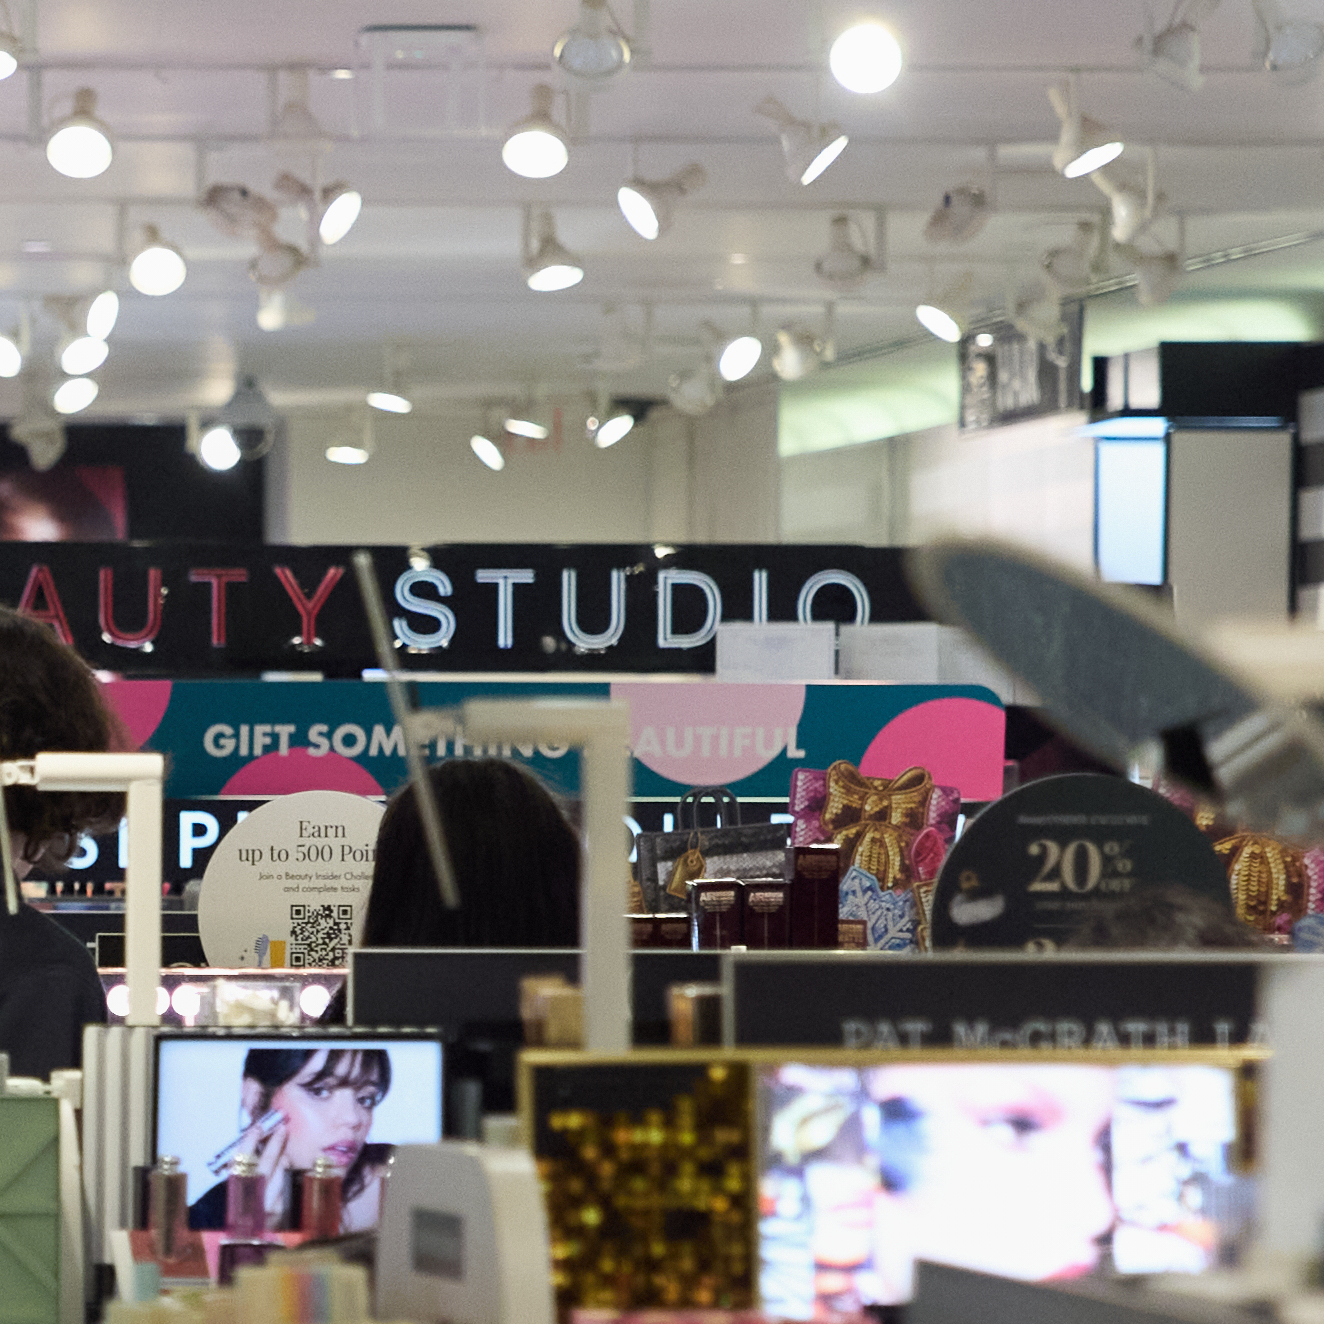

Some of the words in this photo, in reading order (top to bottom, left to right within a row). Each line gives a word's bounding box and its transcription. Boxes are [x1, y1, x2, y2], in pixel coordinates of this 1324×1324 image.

[391, 567, 871, 650] STUDIO
[203, 723, 296, 758] GIFT
[298, 820, 346, 839] Earn
[238, 847, 263, 866] up
[270, 845, 289, 862] to
[295, 843, 333, 863] 500
[258, 871, 275, 881] Join
[285, 871, 313, 883] Beauty
[315, 871, 342, 881] Insider
[283, 884, 300, 893] and
[302, 884, 339, 895] complete
[341, 884, 361, 893] tasks
[840, 1017, 934, 1050] PAT
[953, 1017, 1191, 1050] McGRATH
